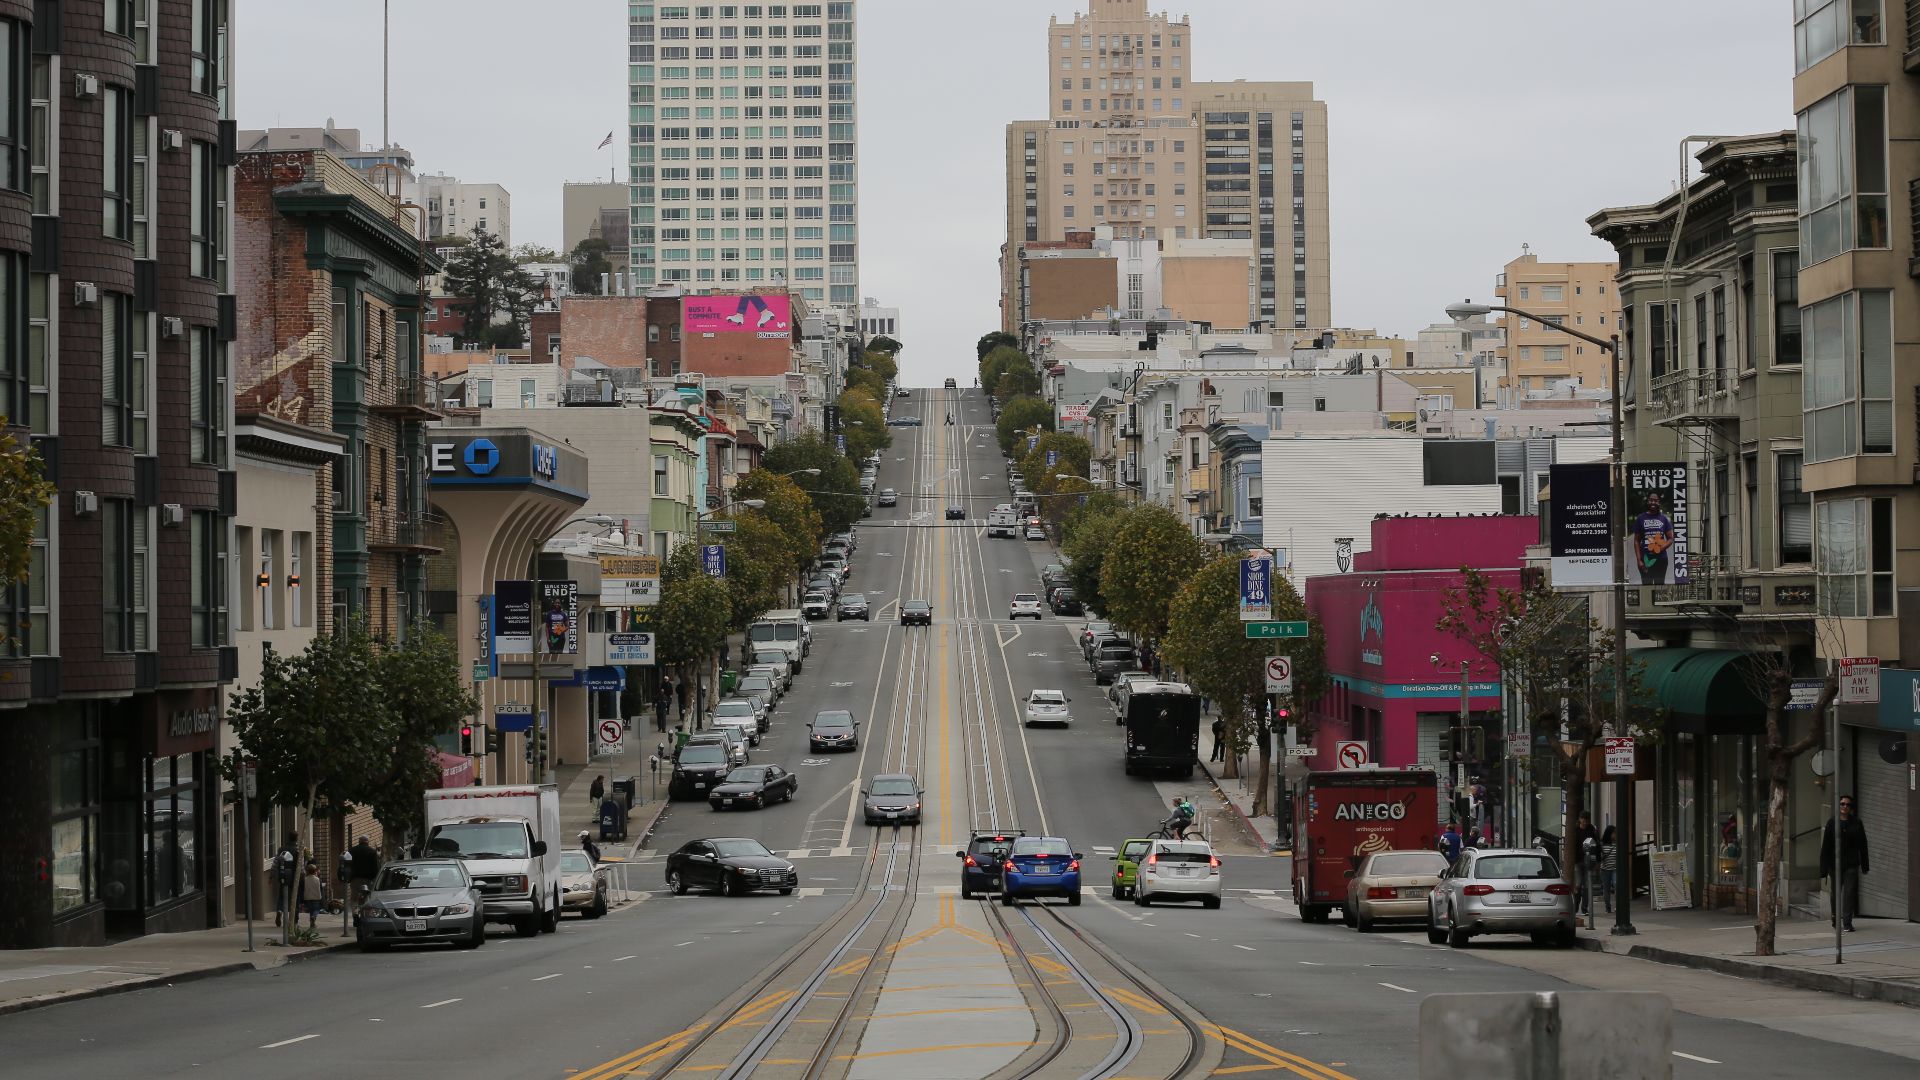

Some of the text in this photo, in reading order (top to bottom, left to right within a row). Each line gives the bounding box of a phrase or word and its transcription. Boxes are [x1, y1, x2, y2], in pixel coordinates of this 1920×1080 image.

[423, 443, 456, 471] E
[1632, 476, 1671, 489] END
[1673, 467, 1688, 578] ALZHEIMER'S
[601, 560, 657, 575] LUMIERE
[544, 588, 568, 596] END
[1247, 590, 1264, 600] 49
[569, 583, 577, 650] ALZHEIMER'S
[480, 612, 488, 658] CHASE
[1261, 626, 1293, 634] Polk
[1842, 665, 1878, 676] NO STOPPING
[1852, 677, 1868, 686] ANY
[1851, 686, 1870, 695] TIME
[171, 711, 193, 737] Audio
[1335, 803, 1406, 820] AN THE GO
